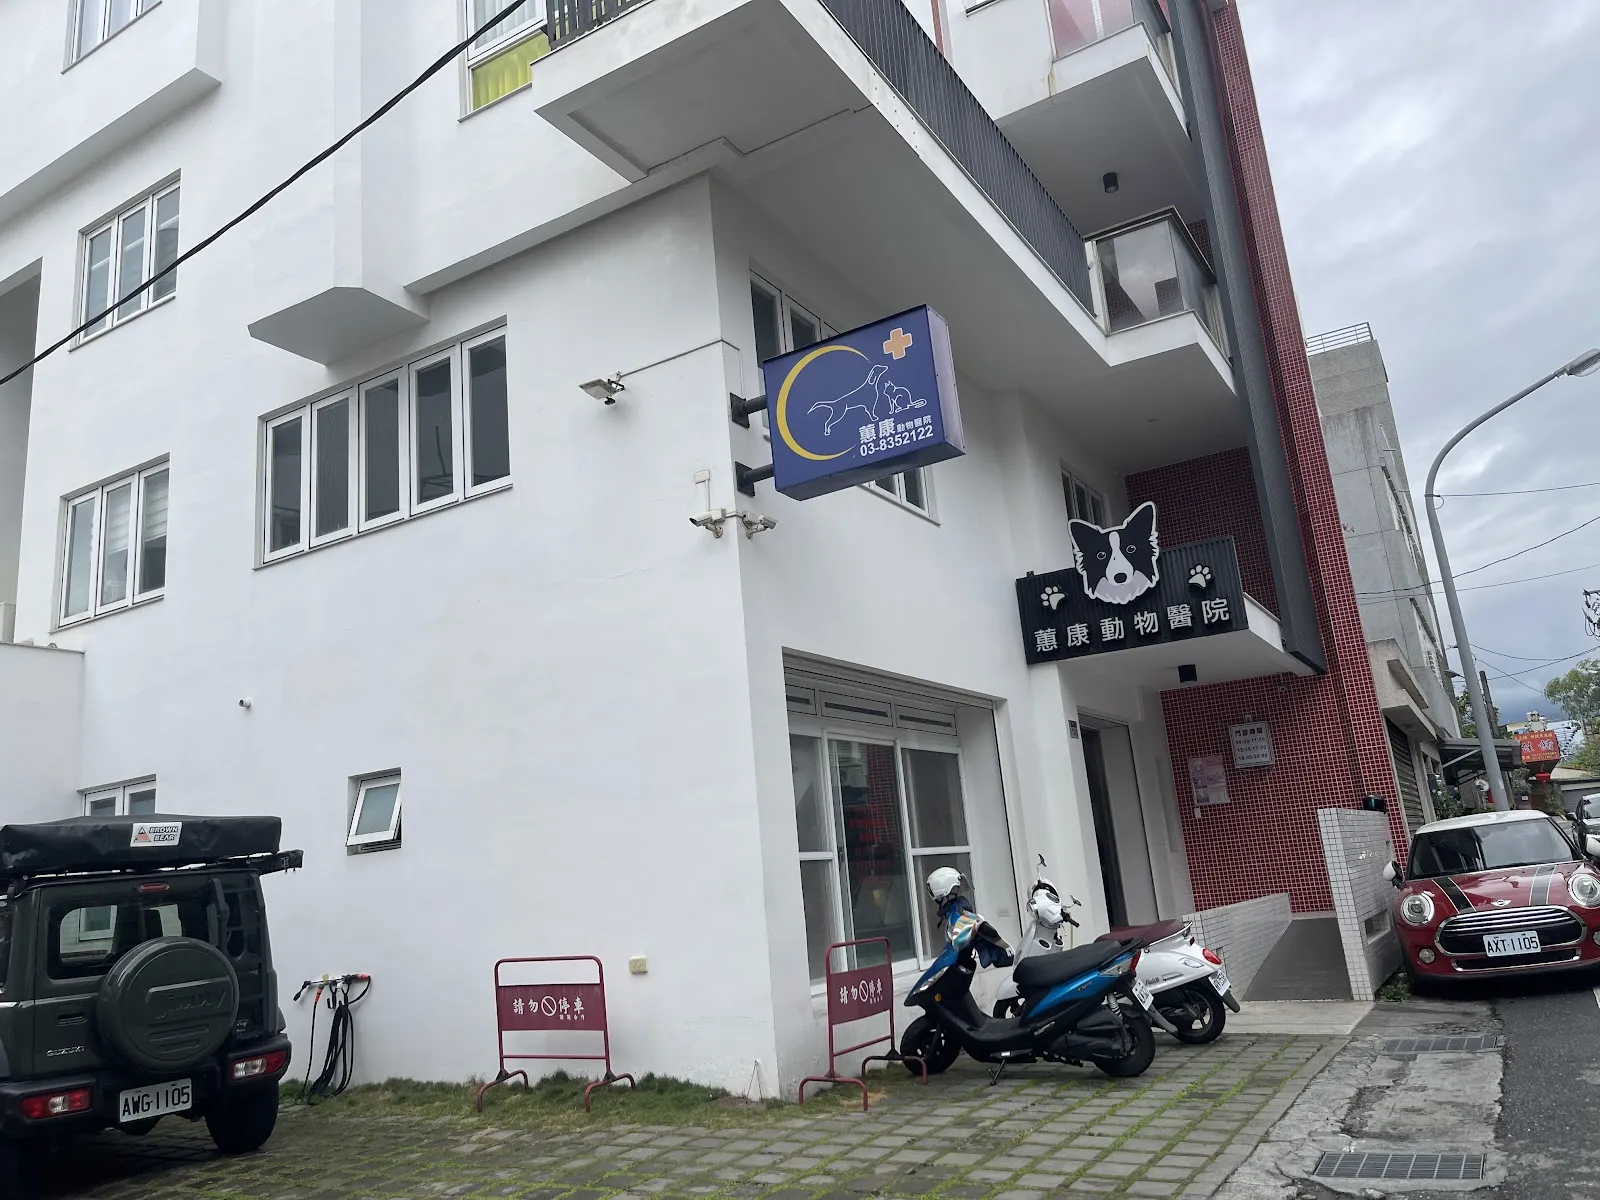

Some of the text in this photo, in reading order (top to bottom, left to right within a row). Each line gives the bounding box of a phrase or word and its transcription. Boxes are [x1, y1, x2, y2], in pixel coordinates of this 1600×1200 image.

[860, 425, 934, 456] 03-8352122
[1034, 597, 1230, 652] 蕙康動物醫院
[149, 826, 179, 834] BROWN
[154, 834, 176, 842] BEAR
[512, 996, 585, 1015] 請勿 停車
[46, 1045, 86, 1057] SUZUKI
